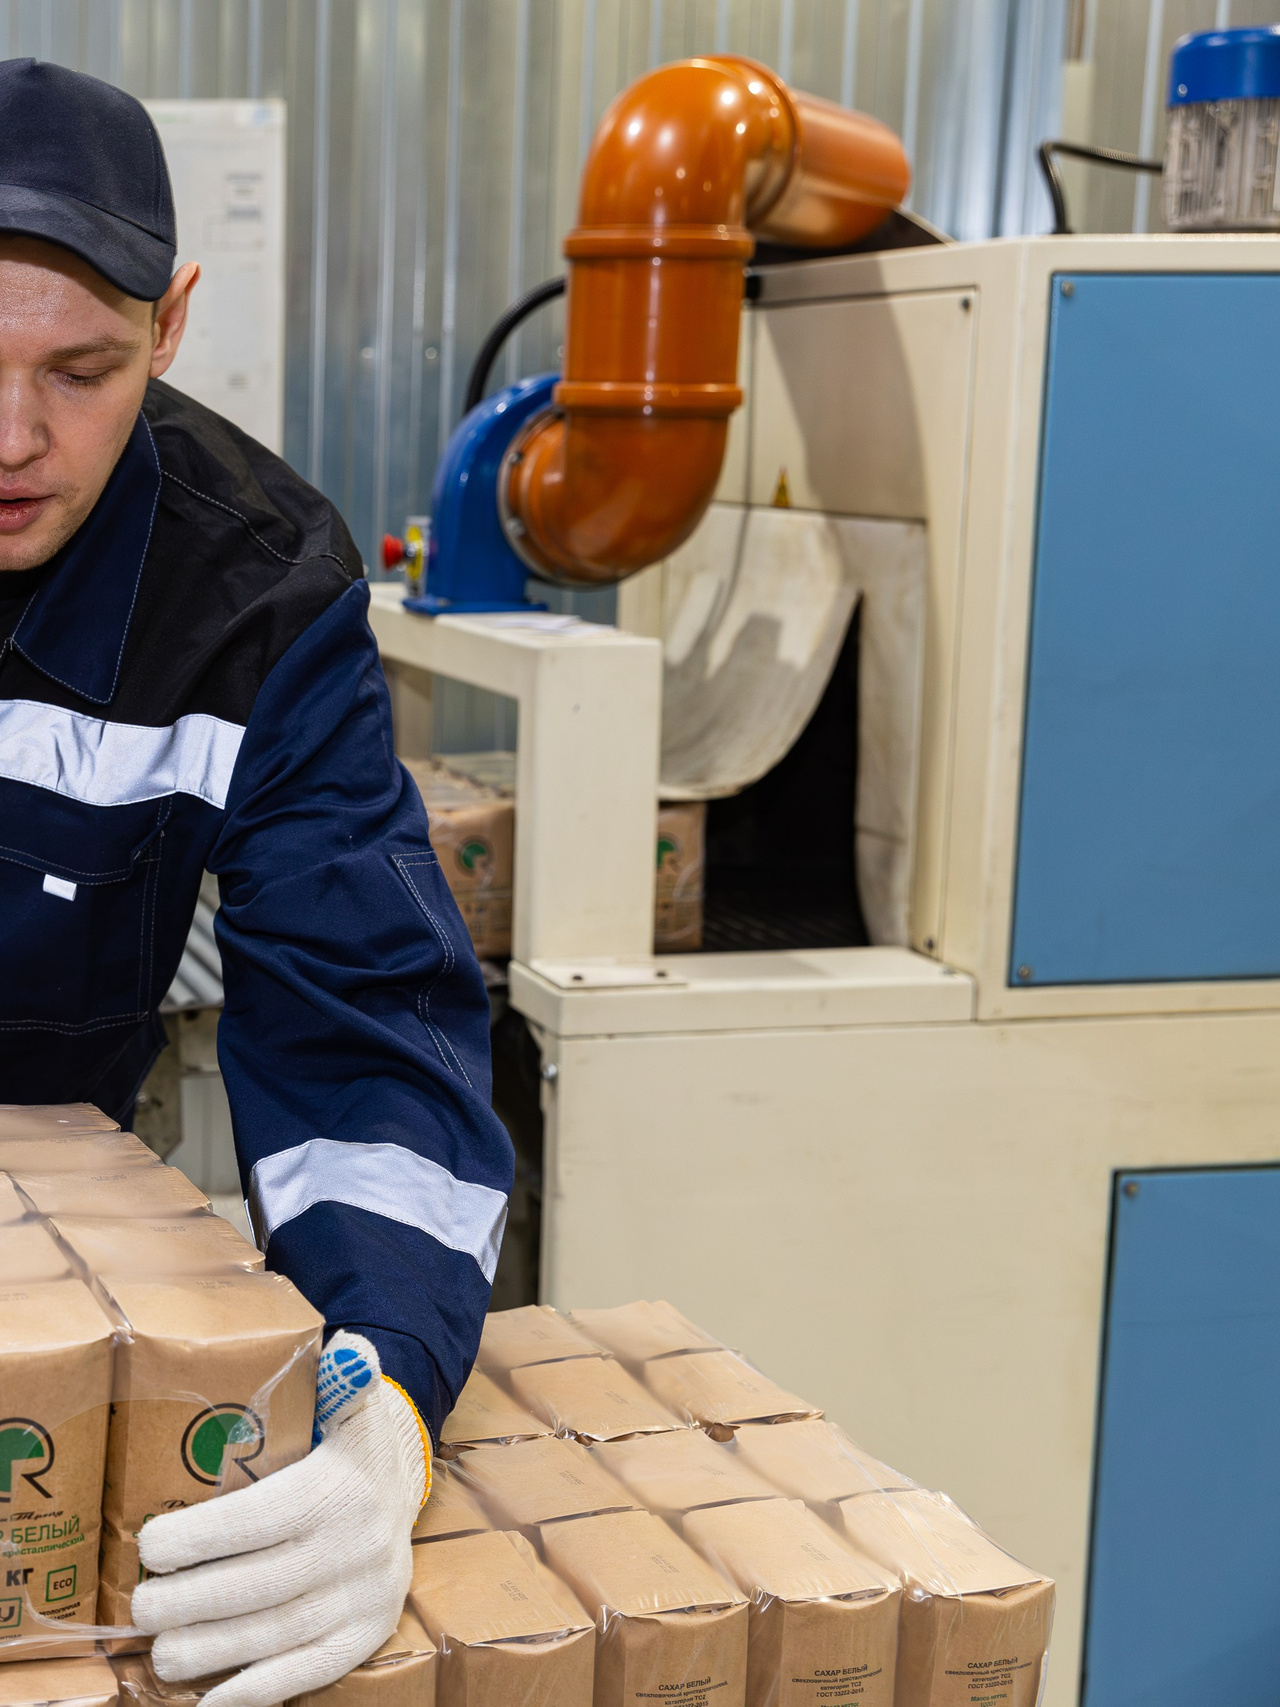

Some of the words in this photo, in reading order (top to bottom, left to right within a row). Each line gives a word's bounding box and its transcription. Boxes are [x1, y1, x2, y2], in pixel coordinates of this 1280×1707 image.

[11, 1514, 80, 1544] БЕЛЫЙ
[994, 1656, 1018, 1667] БЕЛЫЙ
[814, 1669, 841, 1677] САХАР
[842, 1663, 868, 1675] БЕЛЫЙ
[658, 1683, 685, 1691] САХАР
[686, 1676, 711, 1689] БЕЛЫЙ
